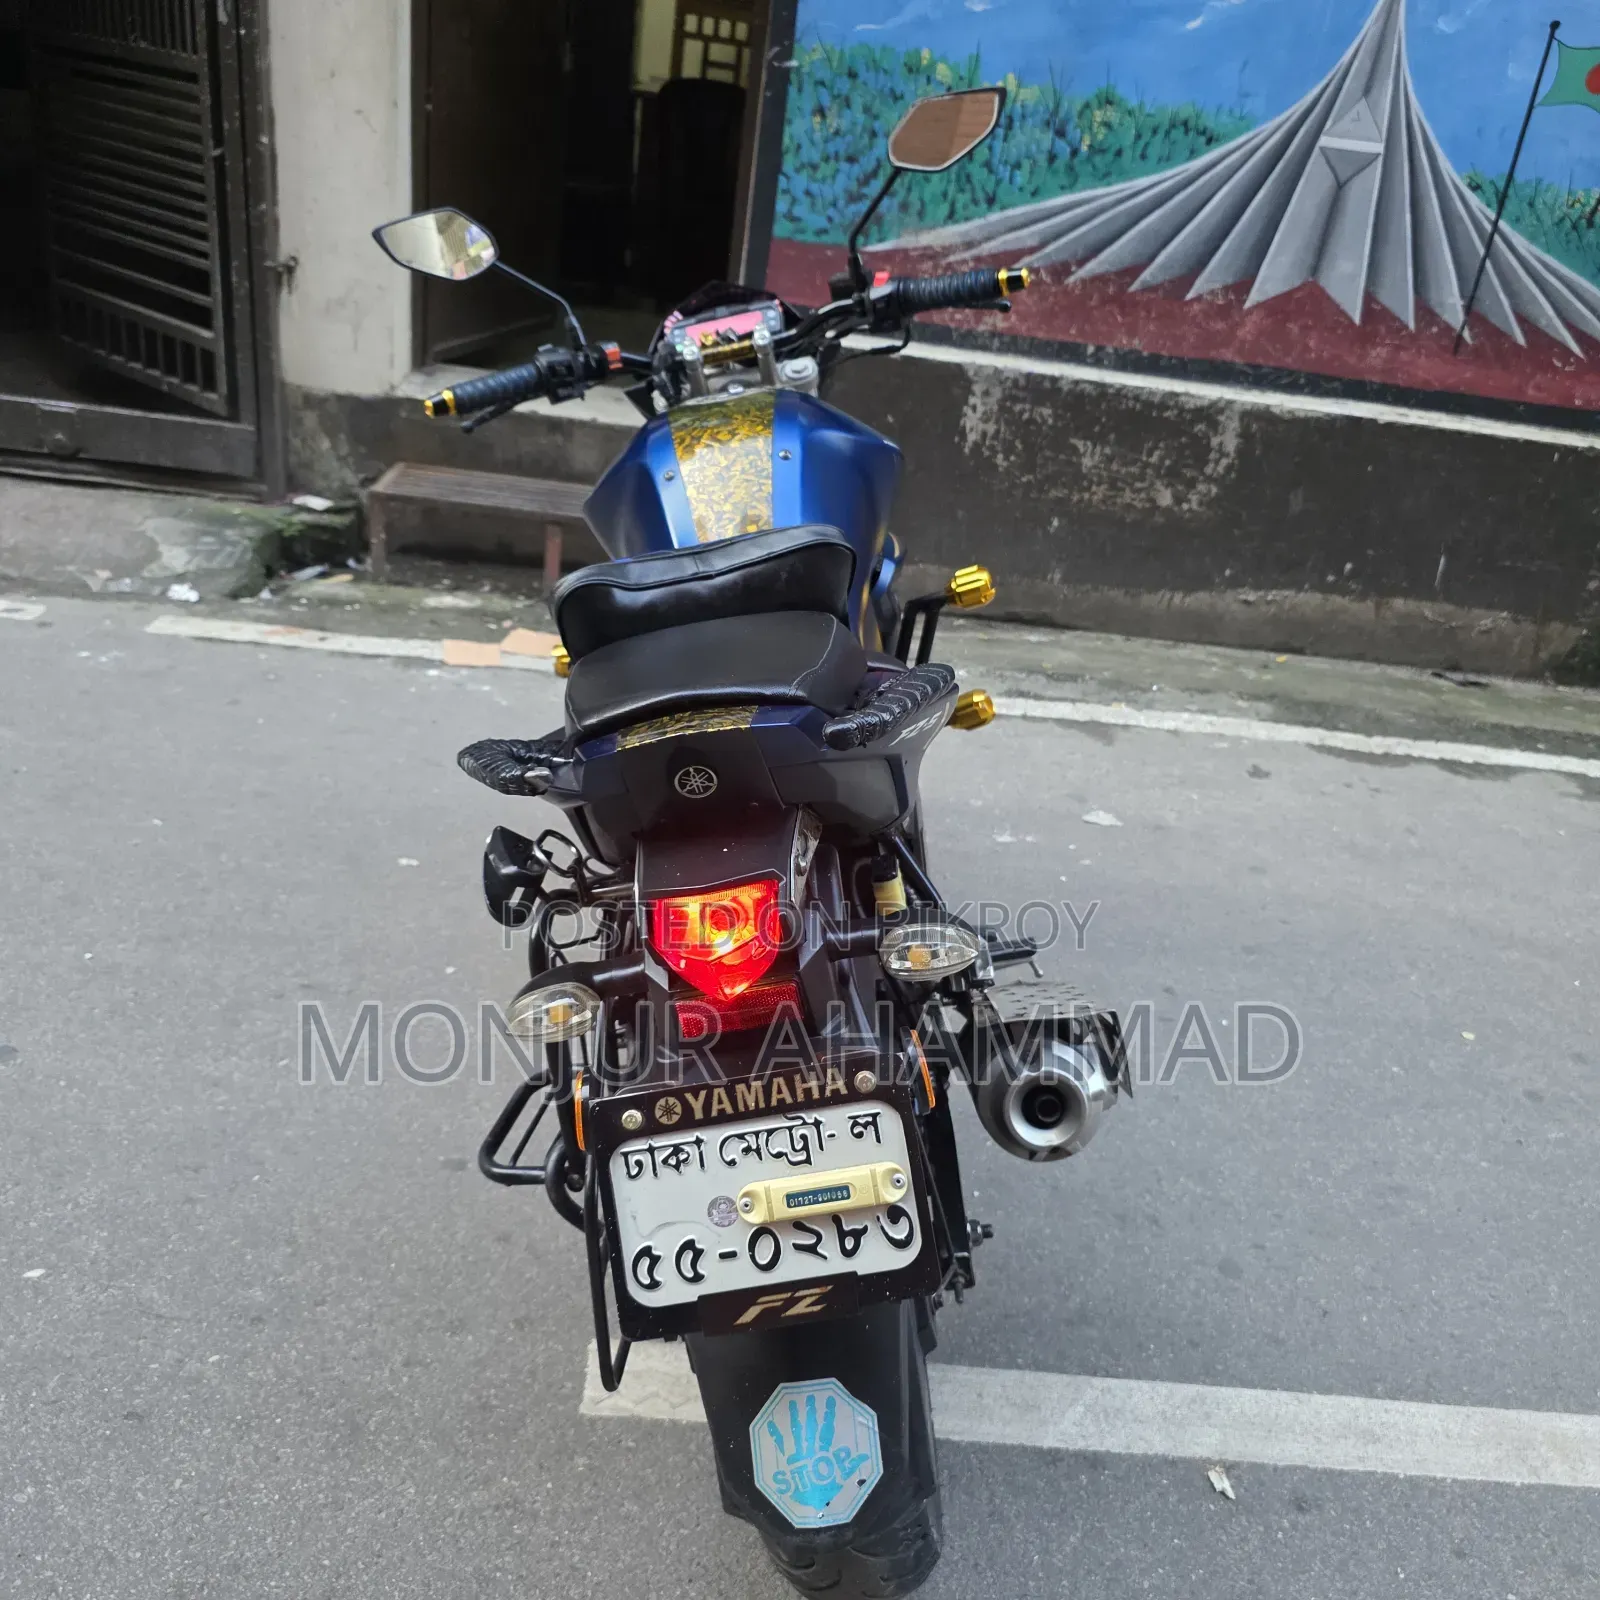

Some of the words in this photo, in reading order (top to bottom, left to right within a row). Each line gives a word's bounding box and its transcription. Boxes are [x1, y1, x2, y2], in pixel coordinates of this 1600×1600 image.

[684, 1067, 849, 1120] YAMAHA
[620, 1134, 707, 1180] ঢাকা
[847, 1111, 883, 1144] ল
[733, 1285, 834, 1326] FZ
[772, 1445, 854, 1496] STOP
